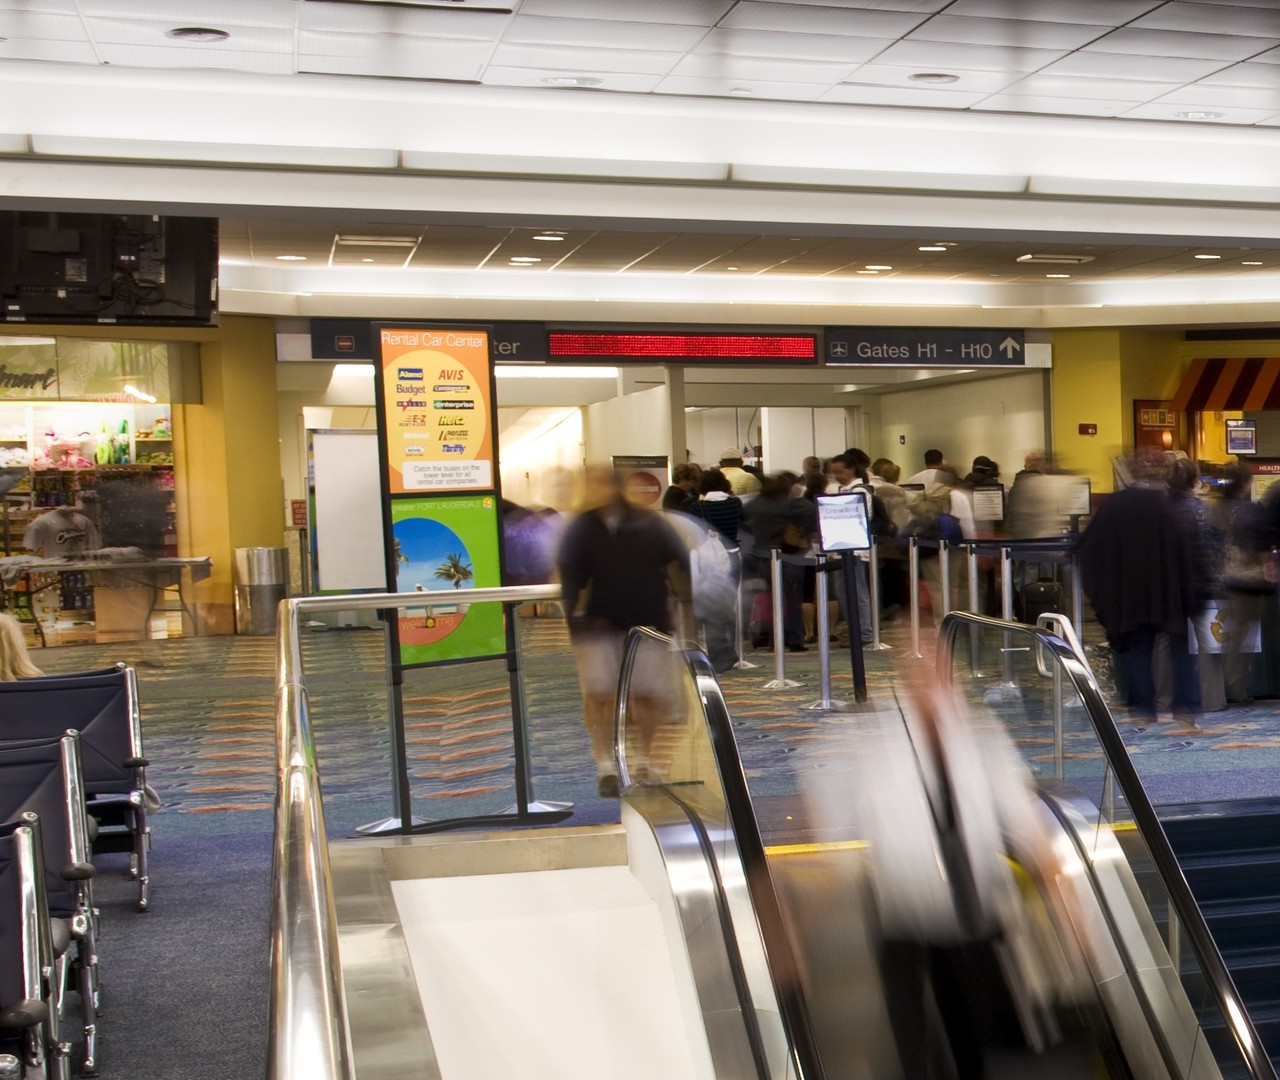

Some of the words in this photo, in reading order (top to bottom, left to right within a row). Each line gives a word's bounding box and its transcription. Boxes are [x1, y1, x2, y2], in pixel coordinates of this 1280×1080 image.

[380, 332, 418, 346] Rental
[422, 333, 443, 346] Car
[446, 334, 484, 347] Center
[856, 342, 910, 358] Gates
[918, 343, 937, 358] H1
[961, 343, 993, 359] H10
[438, 370, 464, 380] AVIS
[396, 384, 426, 396] Budget
[402, 616, 454, 630] welcme
